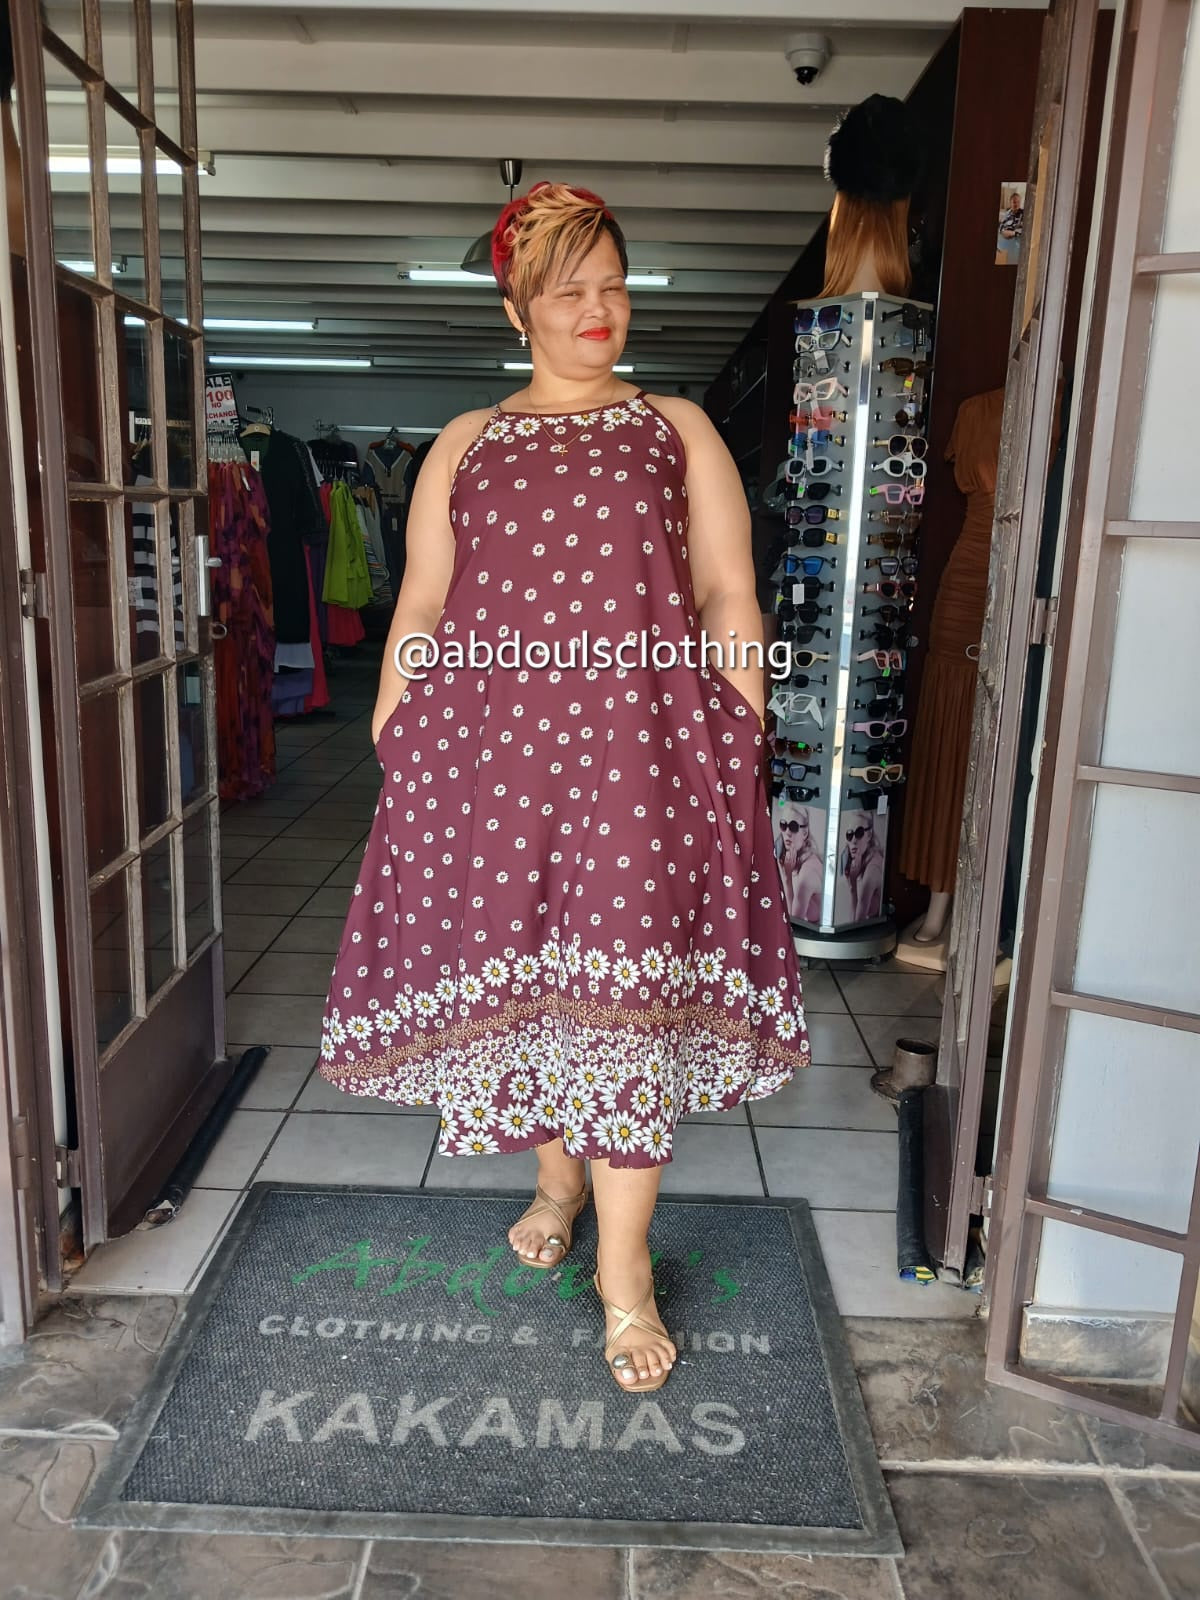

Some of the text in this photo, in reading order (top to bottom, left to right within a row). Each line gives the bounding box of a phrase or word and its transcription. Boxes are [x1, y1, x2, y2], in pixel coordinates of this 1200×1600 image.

[206, 375, 231, 388] ALE
[207, 410, 237, 419] CHANGE
[291, 1236, 742, 1318] Abdou's
[258, 1313, 771, 1355] CLOTHING & FION
[243, 1389, 746, 1457] KAKAMAS
